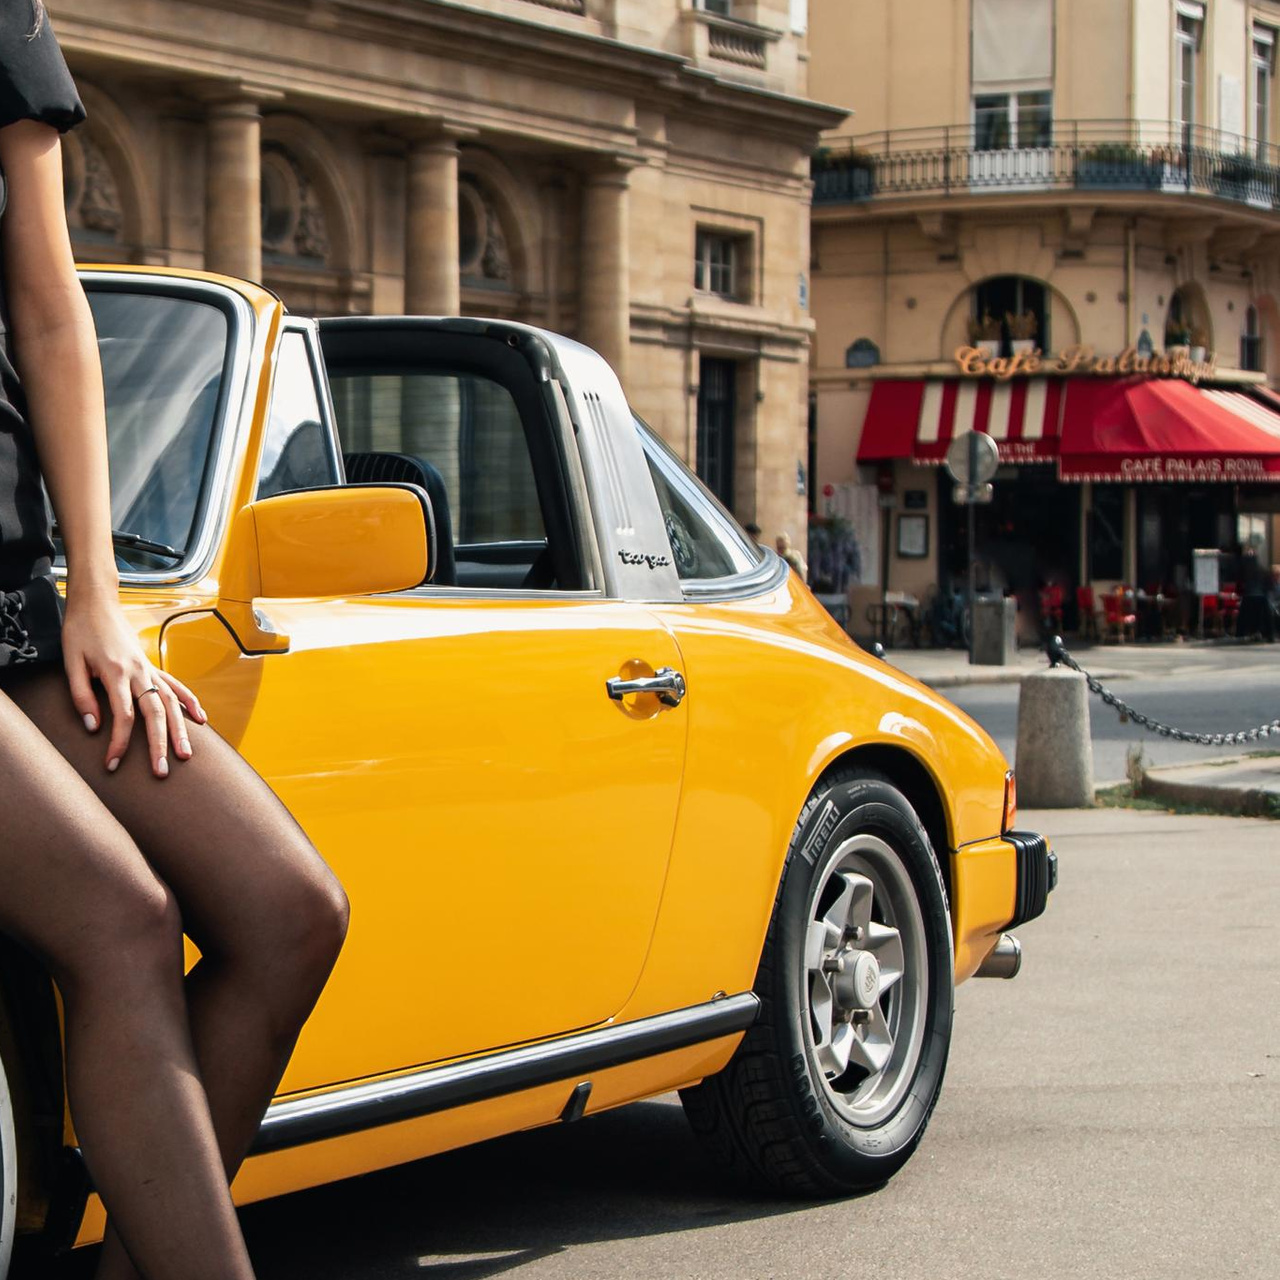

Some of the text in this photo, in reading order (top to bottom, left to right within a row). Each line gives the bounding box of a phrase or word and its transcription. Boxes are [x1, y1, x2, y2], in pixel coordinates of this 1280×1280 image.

[955, 344, 1043, 380] Café
[1121, 455, 1162, 473] CAFÉ
[1165, 457, 1221, 473] PALAIS
[618, 548, 672, 570] targa
[800, 799, 841, 867] PIRELLI
